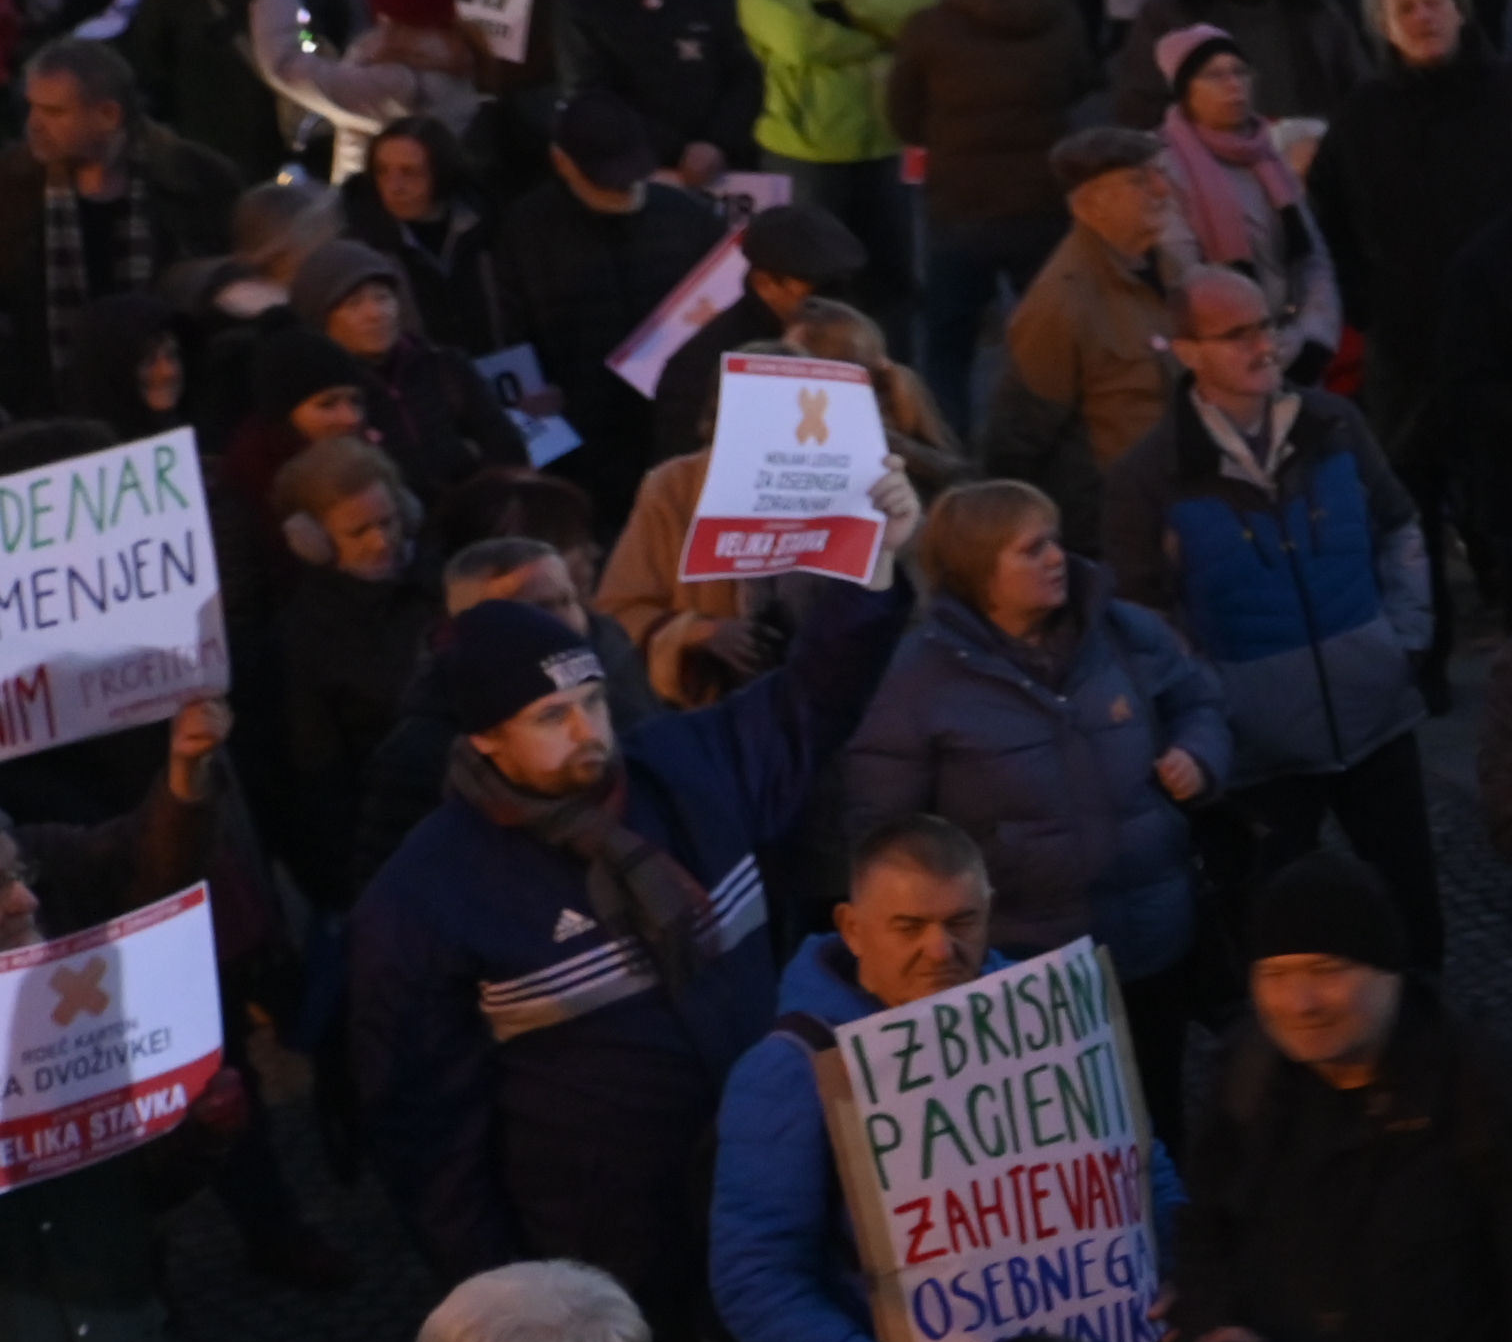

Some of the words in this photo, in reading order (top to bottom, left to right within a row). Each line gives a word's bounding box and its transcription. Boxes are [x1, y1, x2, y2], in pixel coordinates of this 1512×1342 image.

[34, 1026, 173, 1094] DVOŽIVKE!
[0, 1119, 82, 1167] ELIKA
[88, 1082, 188, 1141] STAVKA
[865, 1041, 1131, 1192] PACIENTI
[893, 1144, 1142, 1264] ZAHTEVAMO
